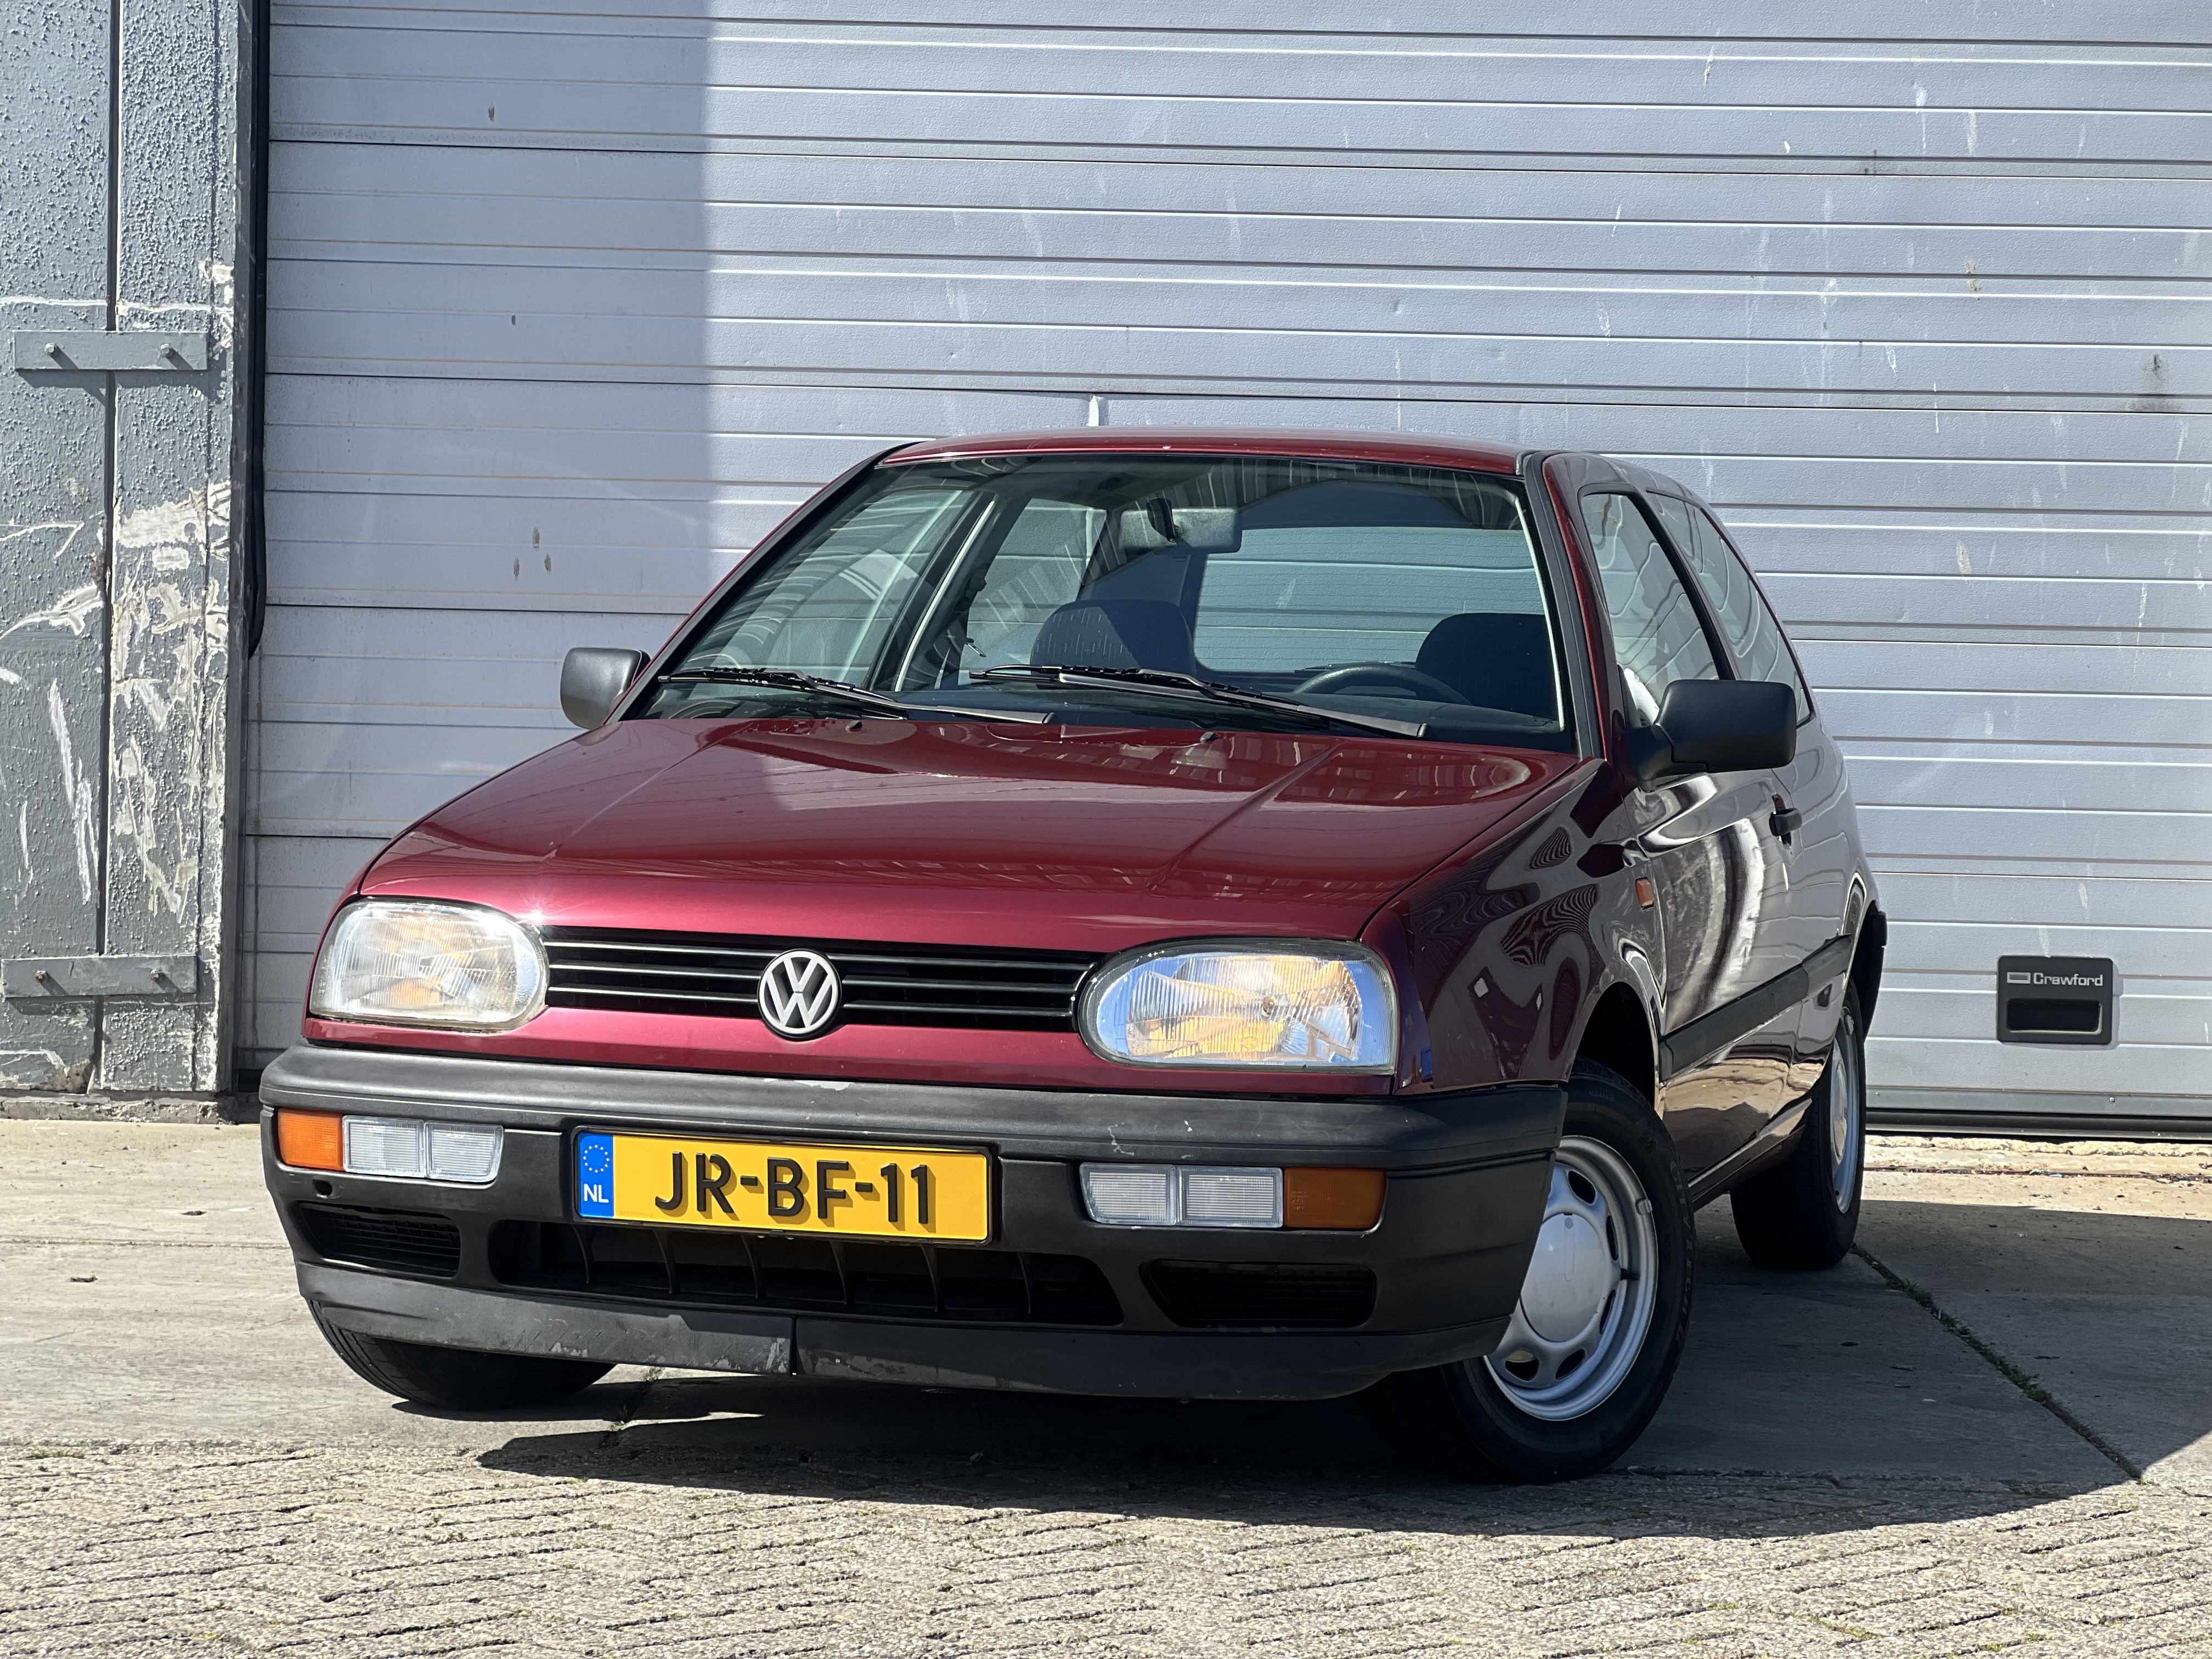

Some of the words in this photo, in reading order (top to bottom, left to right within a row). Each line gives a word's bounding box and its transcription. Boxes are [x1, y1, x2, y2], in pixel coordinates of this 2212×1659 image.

[761, 952, 837, 1032] VW
[2033, 972, 2102, 986] Crawford
[584, 1183, 609, 1203] NL
[655, 1152, 928, 1224] JR-BF-11
